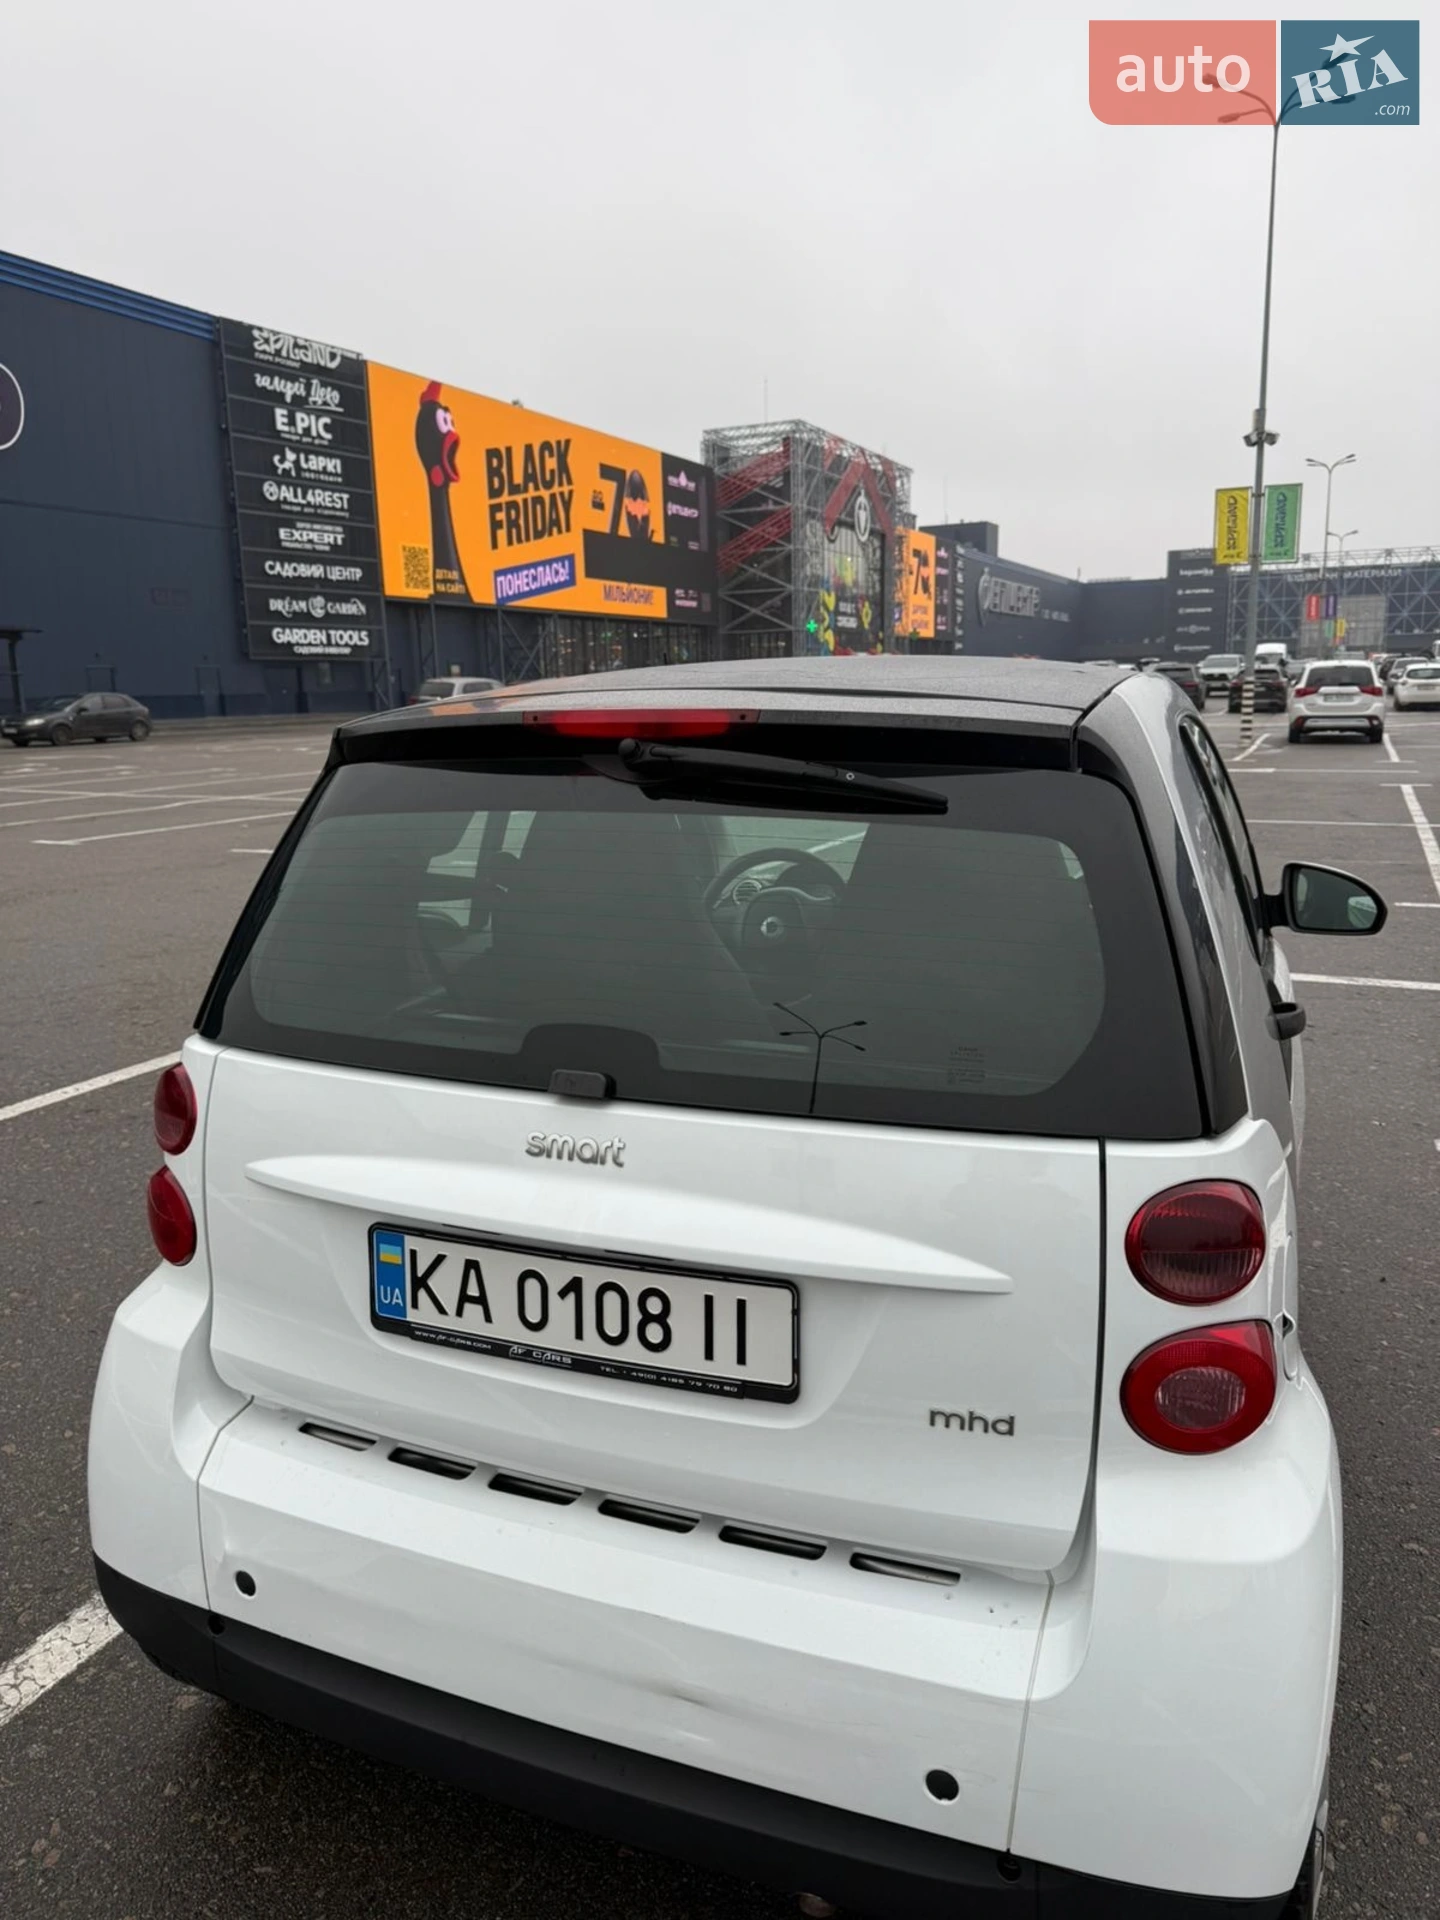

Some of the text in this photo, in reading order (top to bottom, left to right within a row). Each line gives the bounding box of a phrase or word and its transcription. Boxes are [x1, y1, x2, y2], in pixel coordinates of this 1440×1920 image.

[274, 407, 333, 440] E.PIC
[485, 438, 573, 500] BLACK
[279, 485, 350, 510] ALL4REST
[488, 488, 574, 551] FRIDAY
[278, 527, 345, 546] EXPERT
[264, 560, 363, 582] САДОВИЙ ЦЕНТР
[496, 559, 570, 598] ПОНЕСЛАСЬ!
[269, 597, 366, 618] DREAM GARDEN
[272, 627, 369, 646] GARDEN TOOLS
[525, 1131, 626, 1168] smart
[380, 1284, 403, 1307] UA
[409, 1247, 748, 1366] KA 0108 II
[533, 1350, 572, 1365] CARS
[929, 1409, 1015, 1436] mhd
